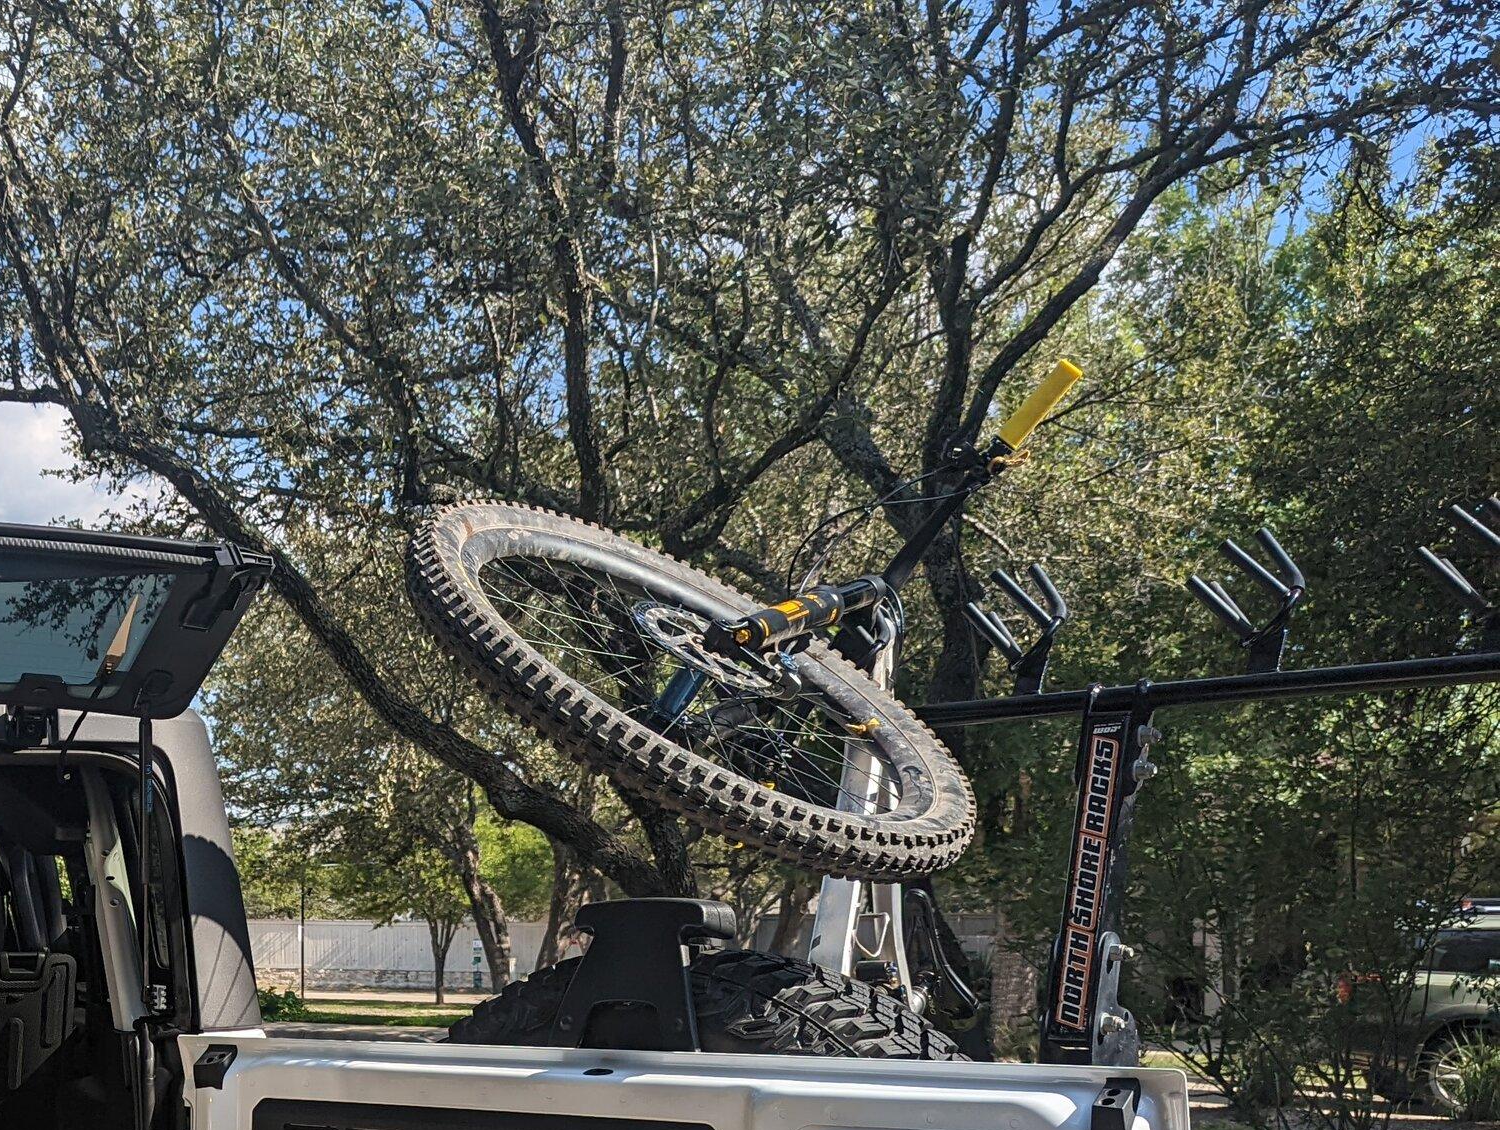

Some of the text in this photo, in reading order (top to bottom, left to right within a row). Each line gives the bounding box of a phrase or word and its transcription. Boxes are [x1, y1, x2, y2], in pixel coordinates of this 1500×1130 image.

[1083, 737, 1117, 834] RACKS
[1070, 836, 1103, 930] SHORE
[1059, 931, 1091, 1026] NORTH
